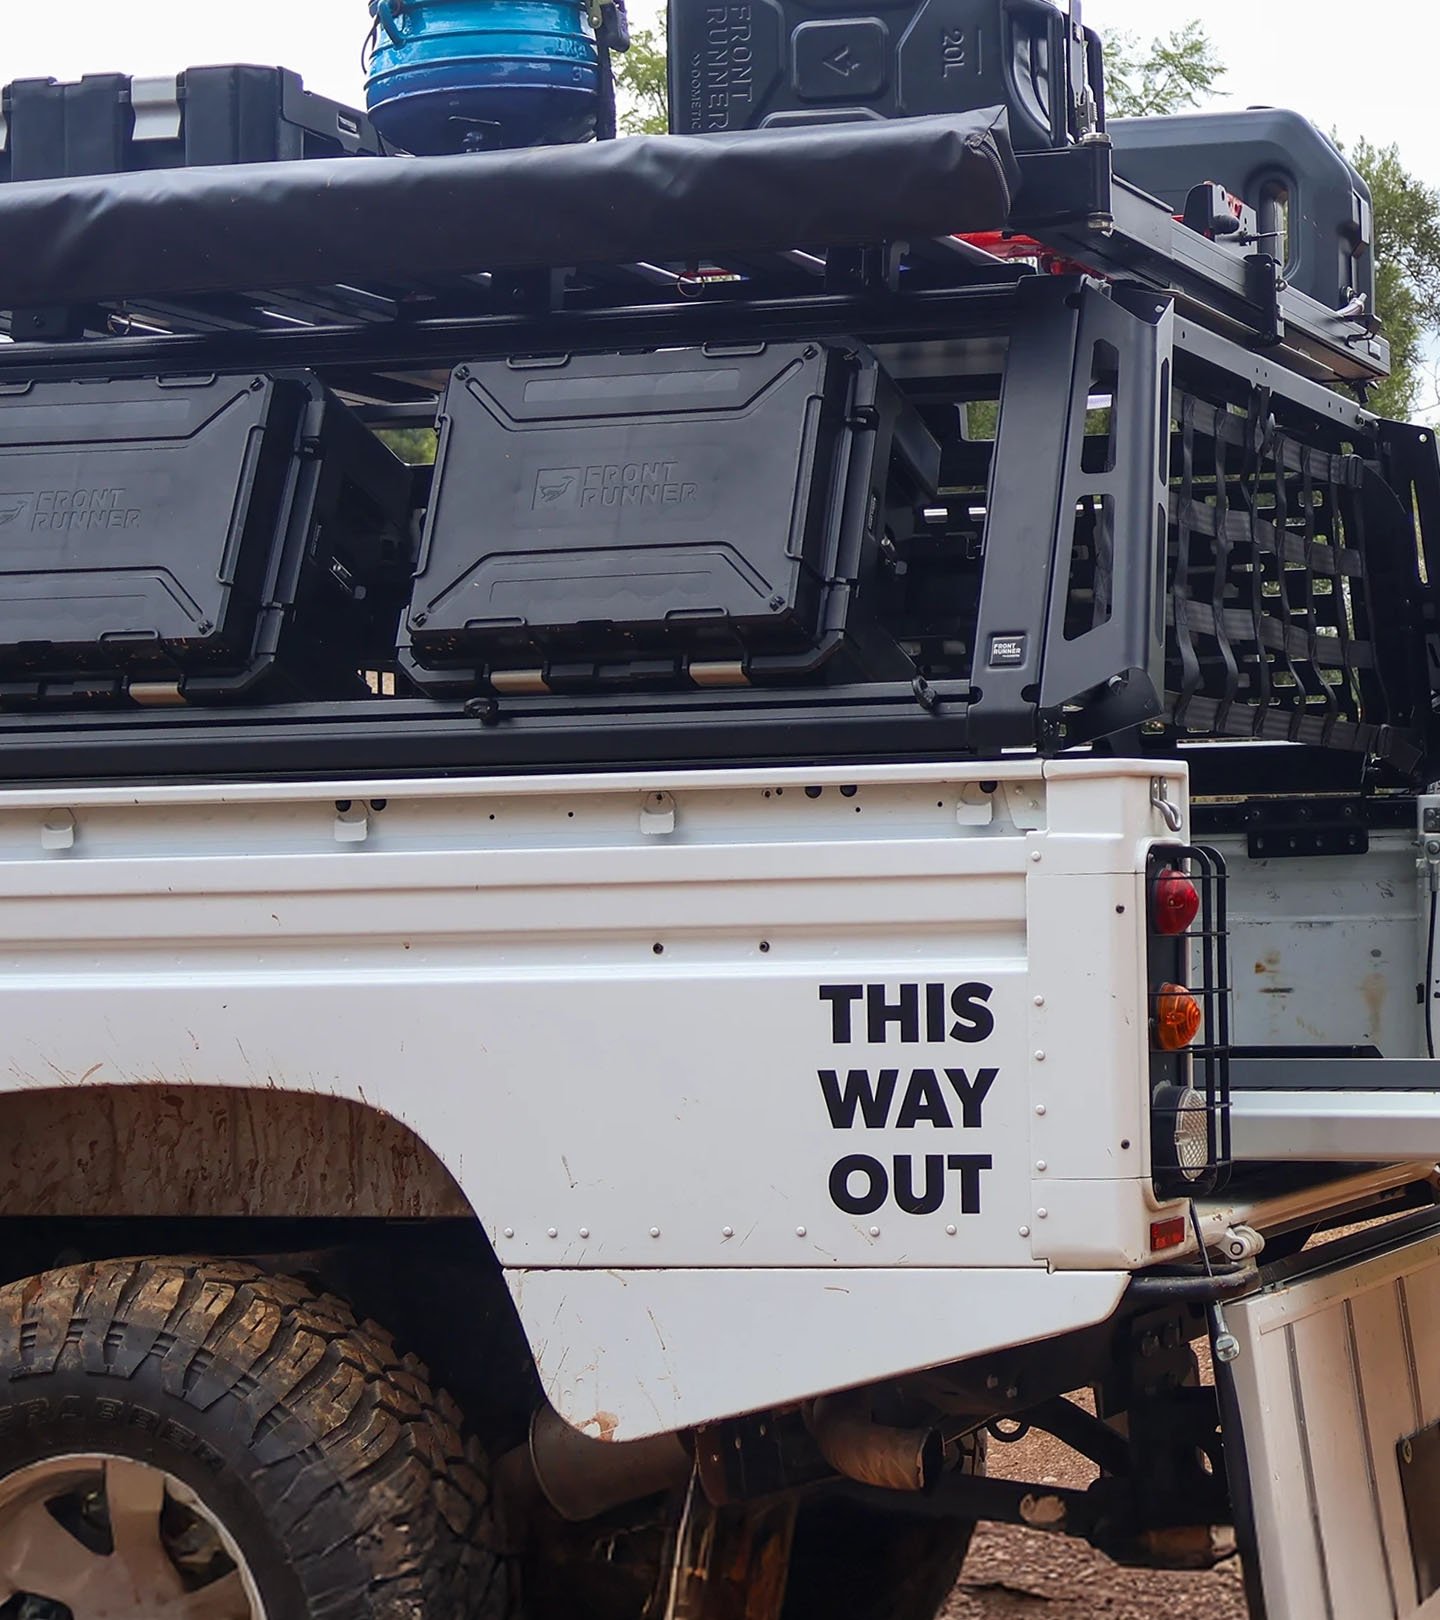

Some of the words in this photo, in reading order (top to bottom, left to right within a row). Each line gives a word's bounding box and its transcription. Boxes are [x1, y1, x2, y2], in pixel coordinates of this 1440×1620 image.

[706, 5, 729, 129] RUNNER
[730, 4, 752, 103] FRONT
[942, 30, 965, 78] 20L
[35, 487, 127, 512] FRONT
[579, 482, 698, 509] RUNNER
[580, 460, 680, 488] FRONT
[30, 508, 142, 533] RUNNER
[819, 982, 994, 1043] THIS
[817, 1068, 1000, 1129] WAY
[829, 1154, 992, 1215] OUT
